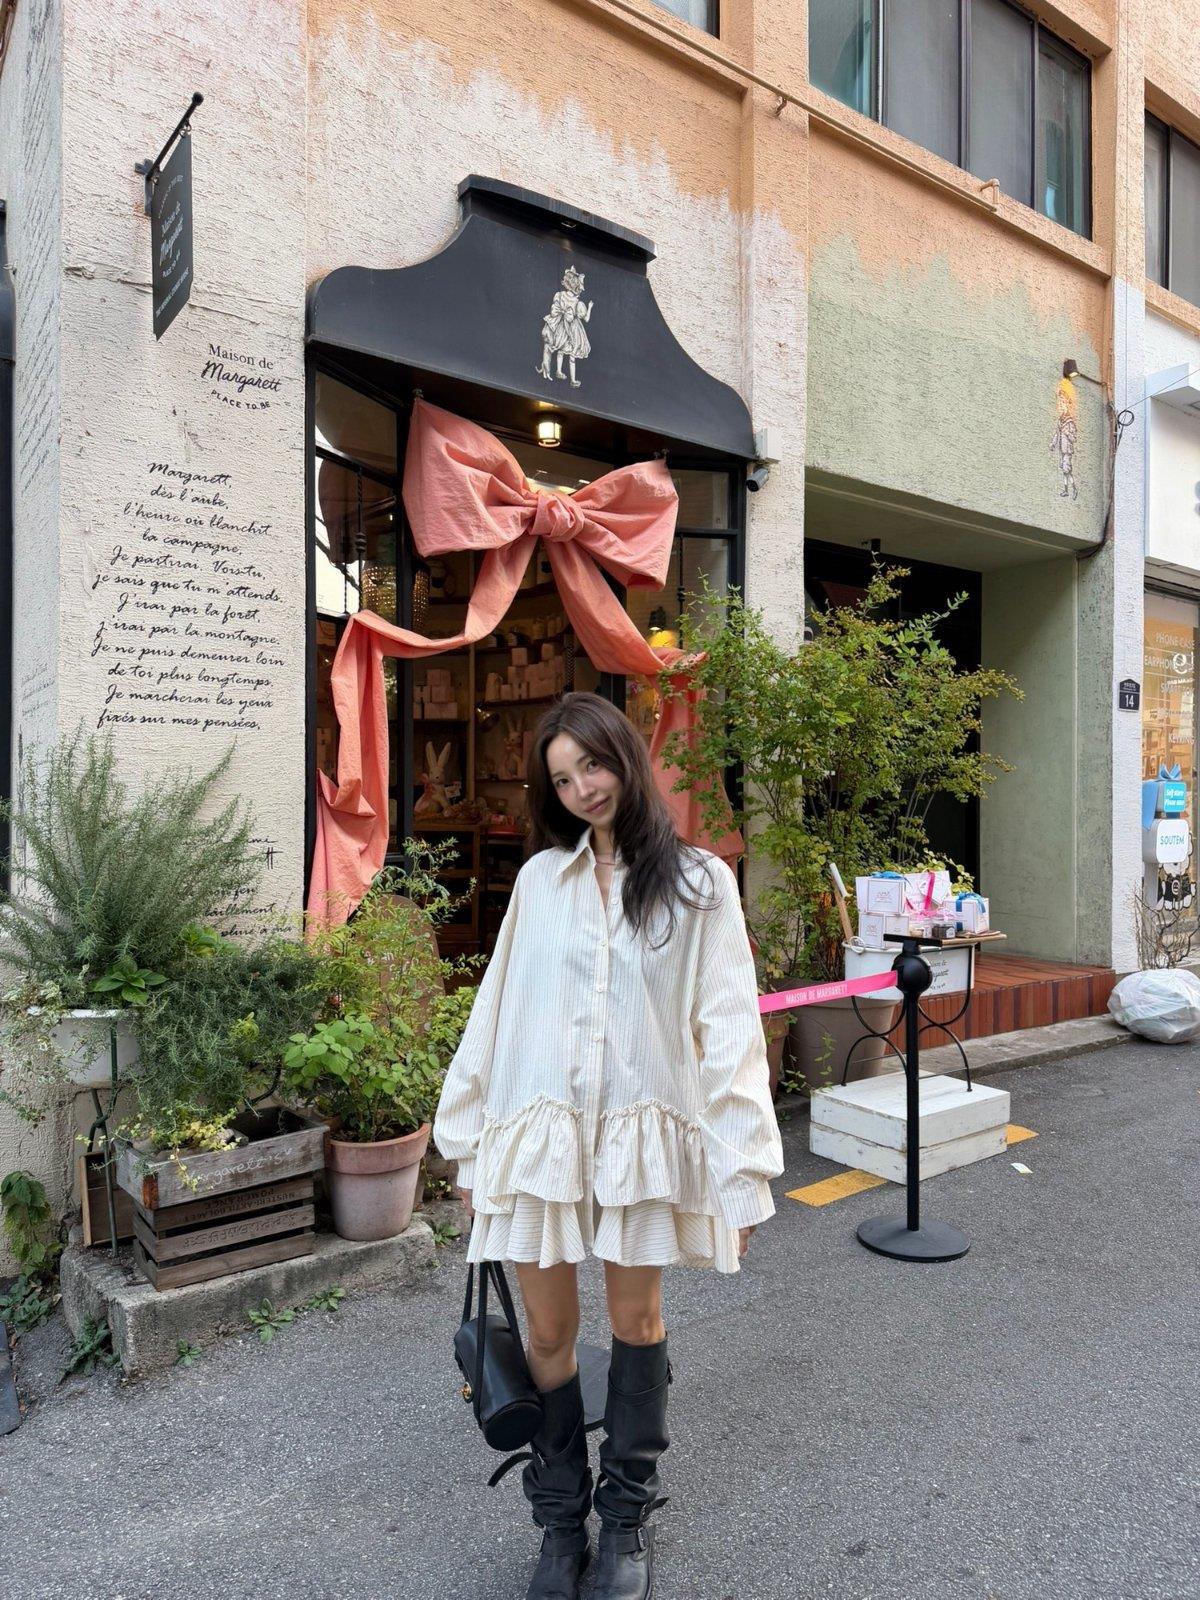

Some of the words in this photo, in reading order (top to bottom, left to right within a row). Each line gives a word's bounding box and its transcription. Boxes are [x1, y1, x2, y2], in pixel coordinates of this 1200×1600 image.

[208, 343, 255, 365] Maison
[258, 357, 274, 370] de
[201, 360, 282, 393] Margarett
[211, 389, 242, 409] PLACE
[260, 401, 271, 410] BE
[142, 528, 158, 542] la
[110, 545, 128, 566] Je
[92, 570, 109, 590] je
[114, 574, 146, 586] sais
[150, 579, 181, 595] que
[182, 579, 201, 592] tu
[168, 605, 199, 618] par
[205, 602, 220, 617] la
[149, 624, 179, 639] par
[184, 622, 200, 637] la
[91, 637, 109, 657] Je
[115, 645, 136, 654] ne
[137, 645, 176, 661] puis
[180, 645, 251, 664] demeurer
[255, 651, 285, 667] loin
[107, 662, 128, 677] de
[129, 664, 154, 678] toi
[156, 666, 194, 685] plus
[105, 684, 125, 705] Je
[129, 688, 211, 705] marcherai
[215, 691, 235, 706] les
[238, 700, 274, 715] yeux
[1125, 694, 1135, 708] 14
[140, 715, 166, 725] sur
[172, 716, 201, 726] mes
[1160, 835, 1185, 845] SOUTEM
[785, 991, 808, 1005] MAISON
[808, 989, 815, 1001] DE
[816, 983, 848, 999] MARGARETT
